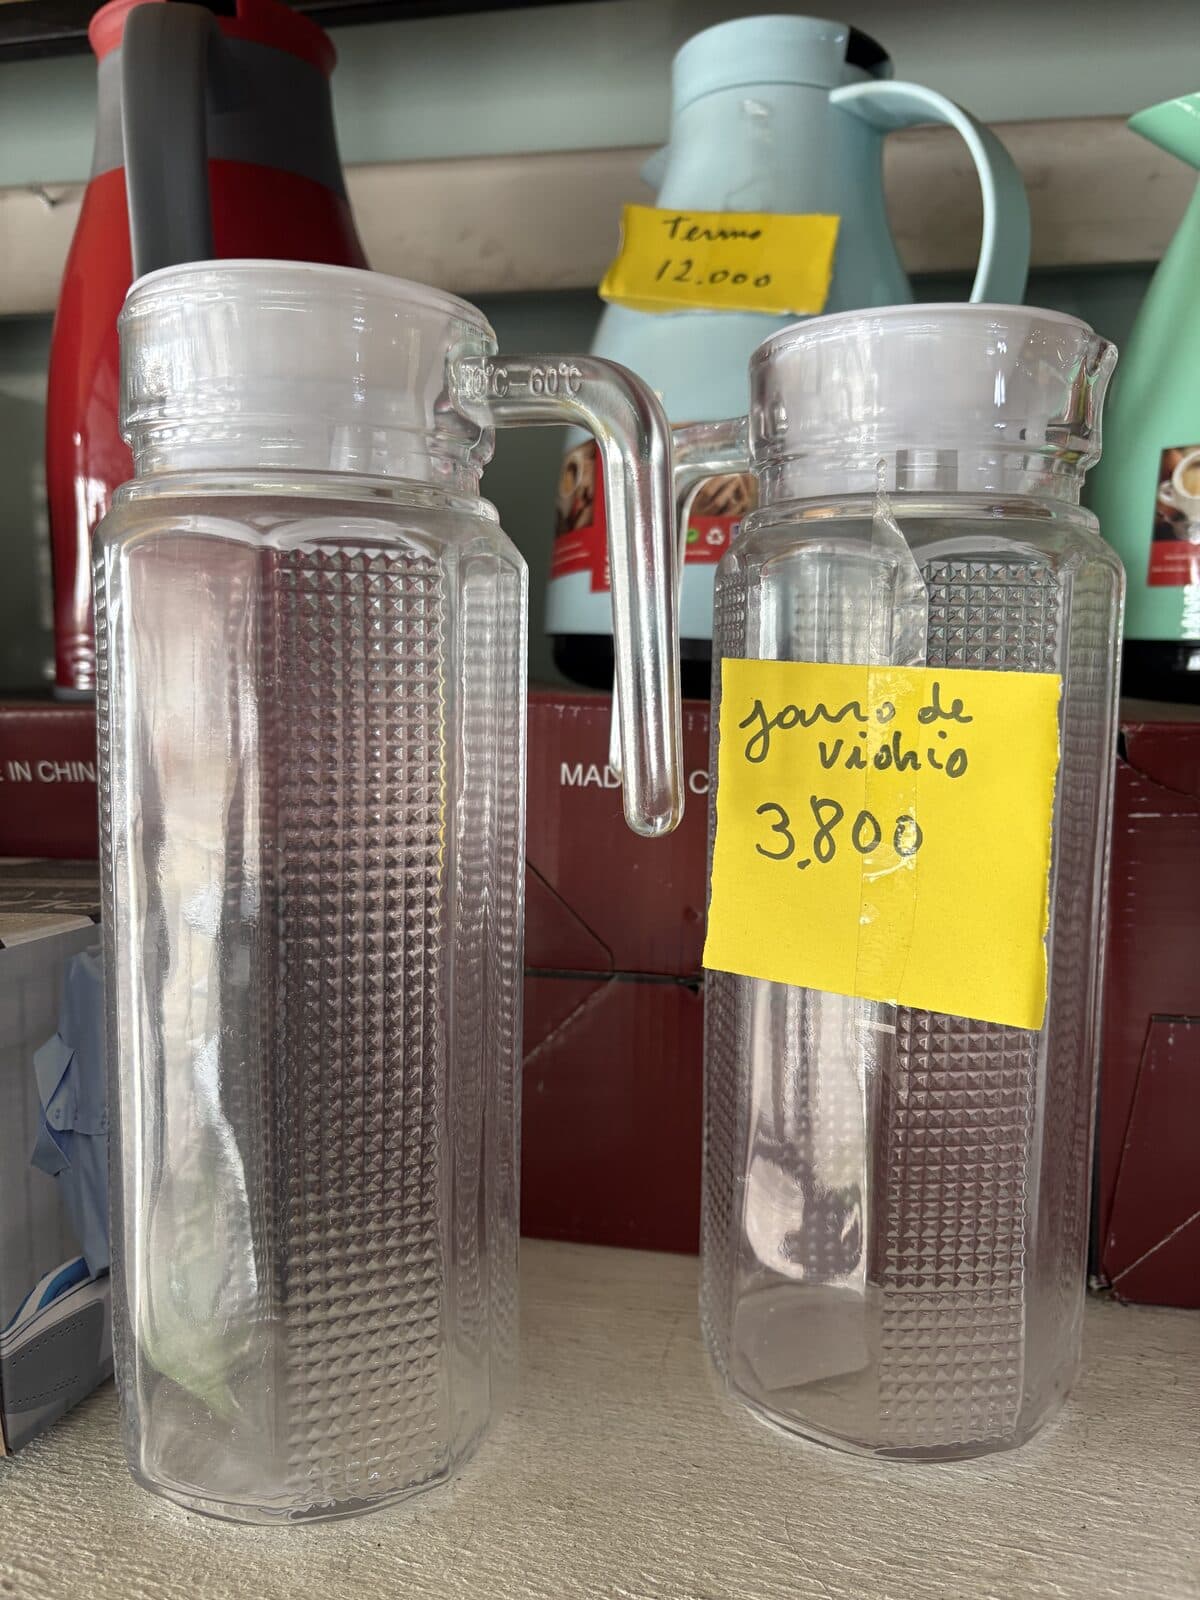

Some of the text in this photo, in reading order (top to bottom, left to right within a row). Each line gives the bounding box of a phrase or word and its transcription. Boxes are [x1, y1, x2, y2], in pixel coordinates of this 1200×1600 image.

[656, 259, 771, 288] 12.000
[918, 682, 973, 724] de
[8, 760, 32, 782] IN
[37, 760, 97, 783] CHIN
[560, 763, 623, 788] MAD
[755, 795, 923, 870] 3.800
